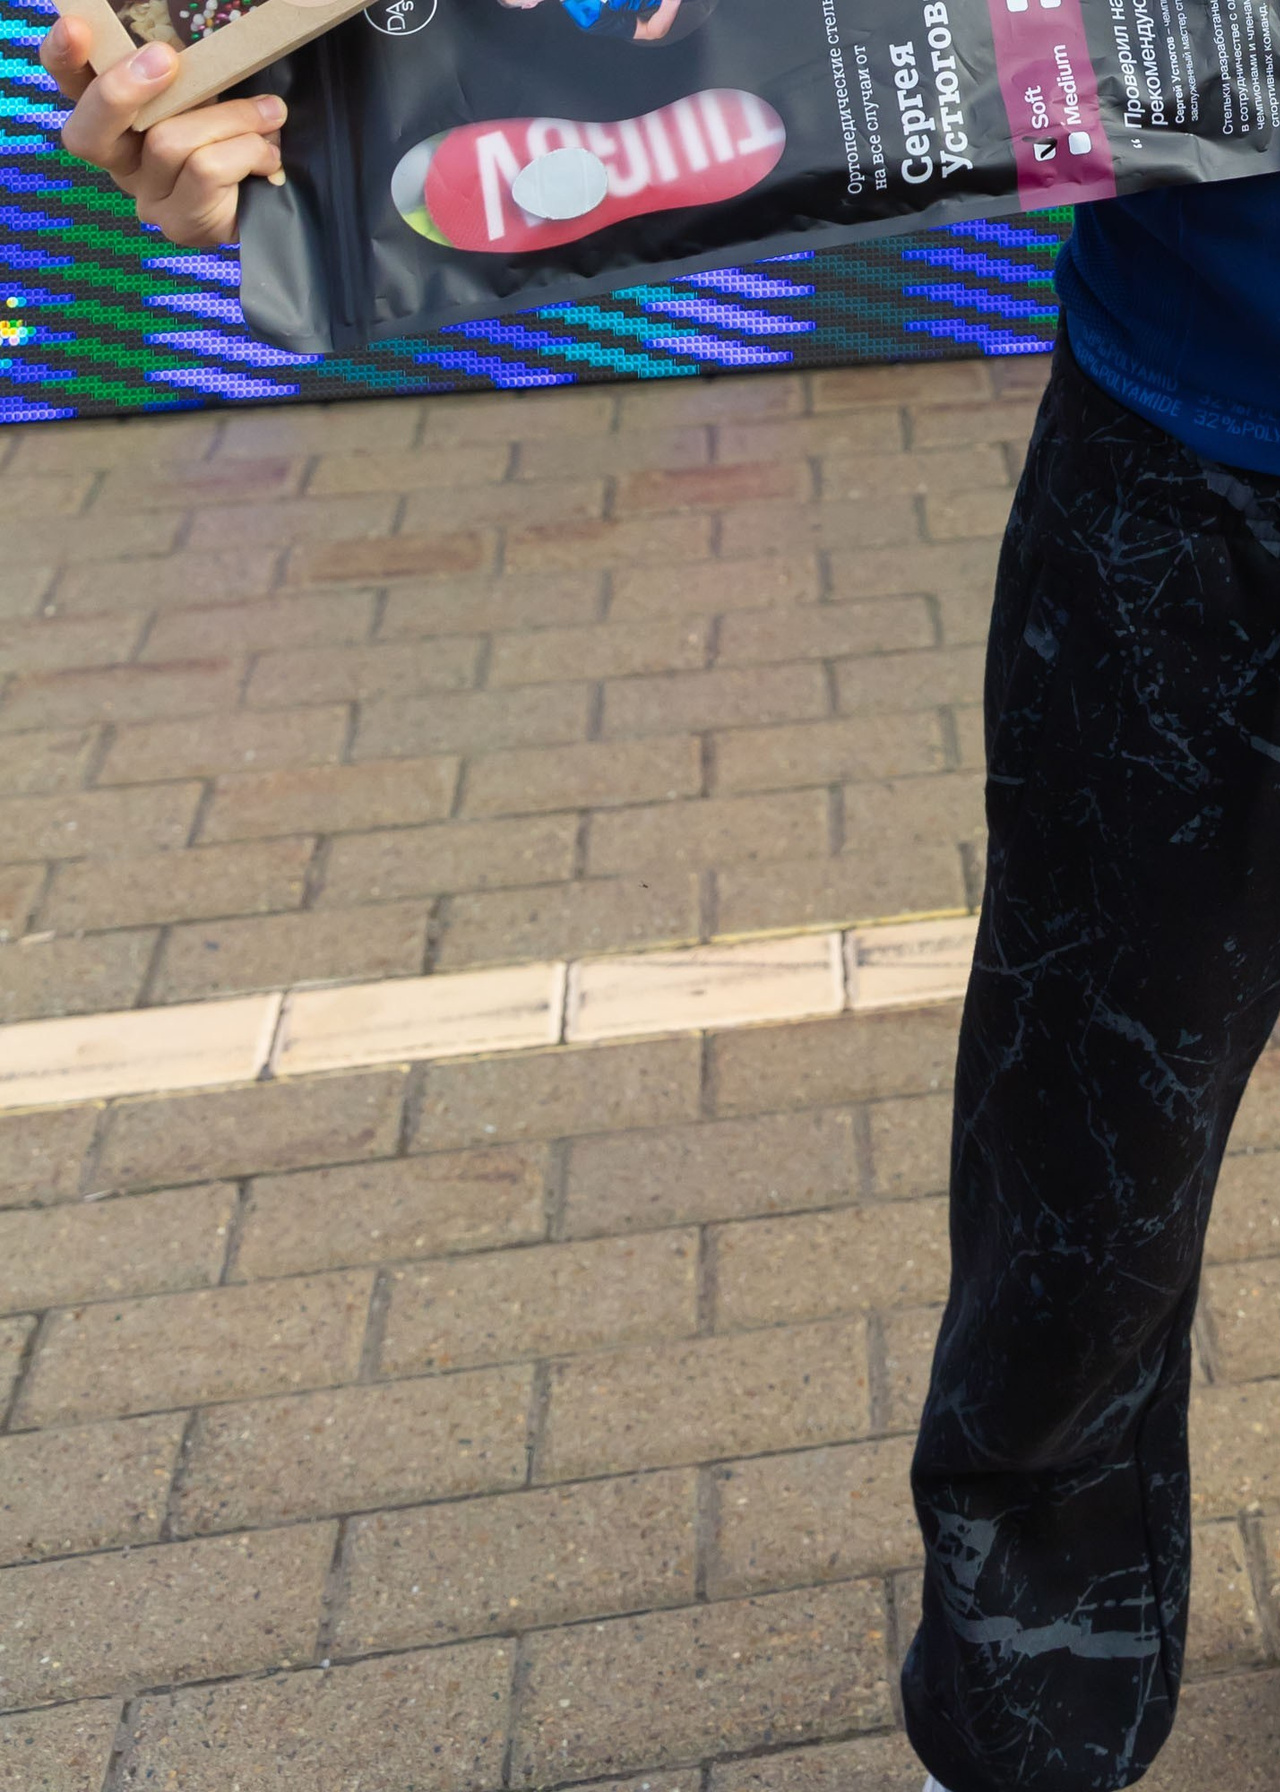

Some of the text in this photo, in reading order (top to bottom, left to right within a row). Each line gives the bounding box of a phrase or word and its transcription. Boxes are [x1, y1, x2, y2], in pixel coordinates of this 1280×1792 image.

[1166, 36, 1181, 83] Устюгов
[1177, 12, 1191, 50] мастер
[1210, 0, 1232, 81] разработаны
[1248, 43, 1256, 51] и
[1024, 85, 1049, 129] Soft
[1053, 44, 1082, 125] Medium
[1113, 25, 1146, 129] Проверил
[1175, 84, 1188, 124] Сергей
[1182, 51, 1200, 122] заслуженный
[1222, 83, 1234, 135] Стельки
[1231, 23, 1250, 123] сотрудничестве
[1249, 54, 1265, 130] чемпионами
[1263, 54, 1280, 127] спортивных
[830, 47, 862, 195] Ортопедические
[854, 45, 887, 190] на все случаи от
[889, 41, 936, 184] Сергея
